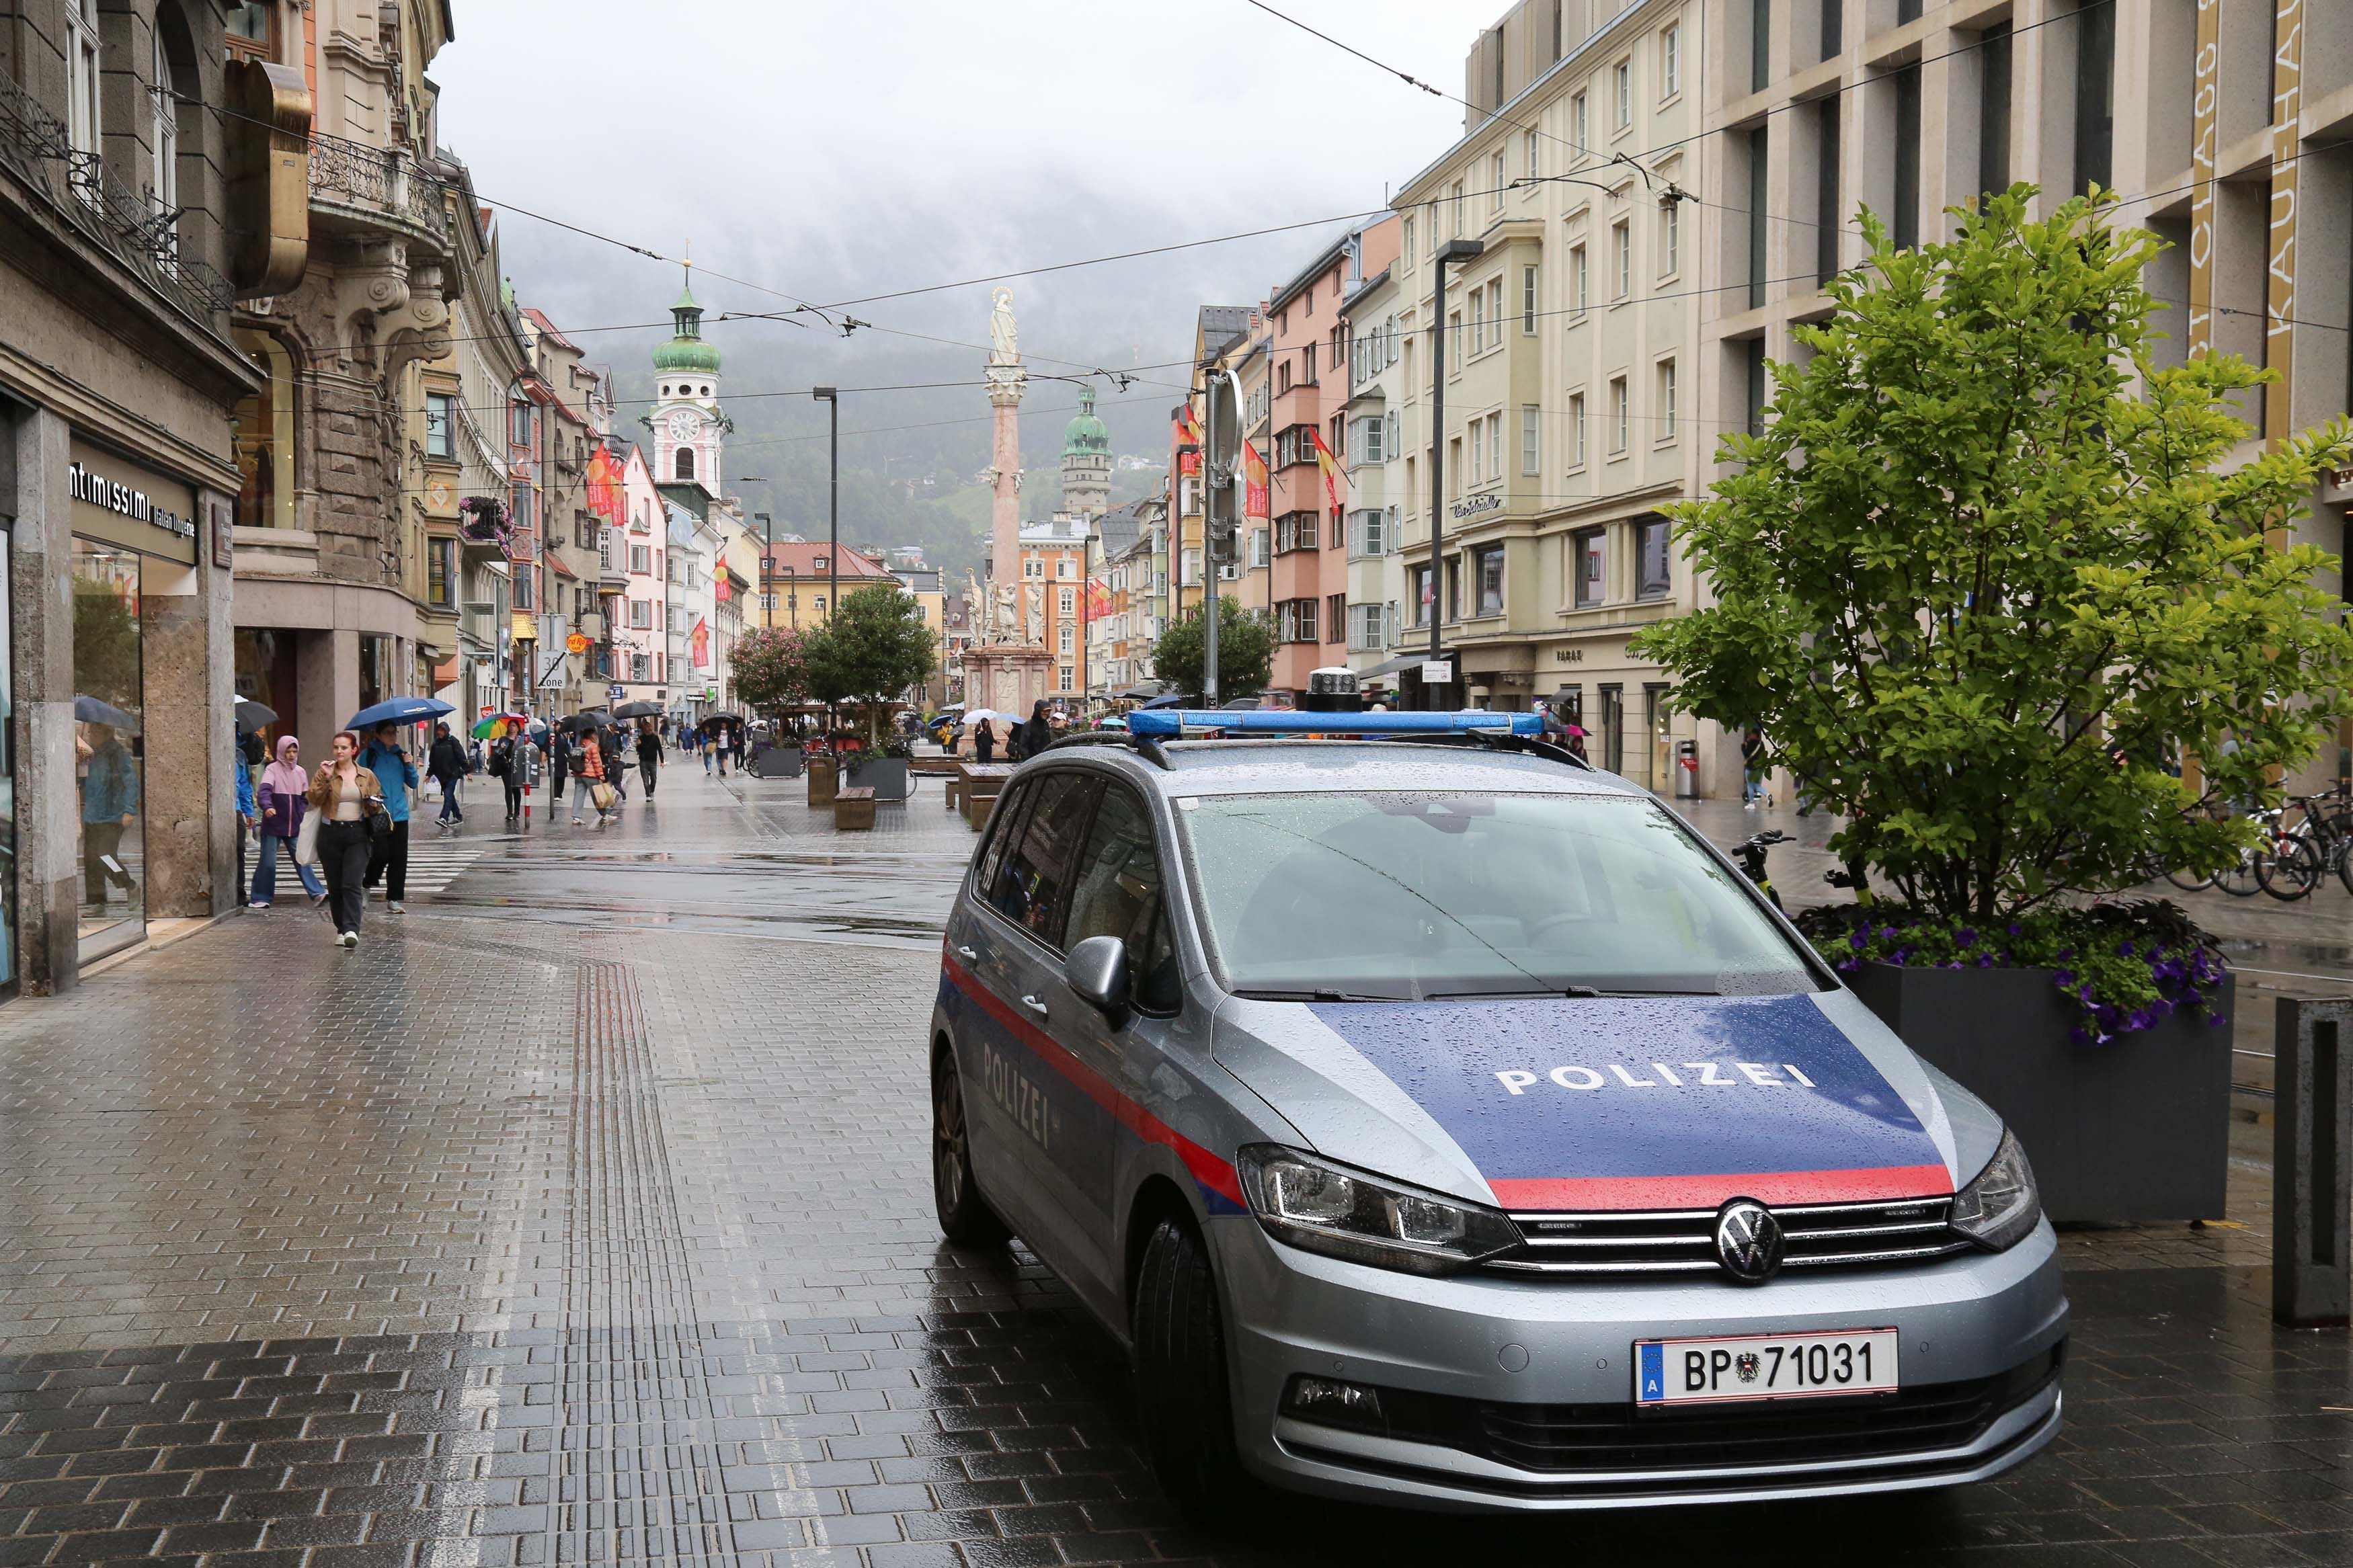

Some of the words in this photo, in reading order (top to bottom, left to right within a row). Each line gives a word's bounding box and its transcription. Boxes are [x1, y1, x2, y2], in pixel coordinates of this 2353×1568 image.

[2190, 42, 2217, 269] CLASS
[154, 505, 173, 532] Italian
[173, 513, 196, 538] lingerie
[544, 657, 559, 671] 30
[541, 677, 563, 687] Zone
[1494, 1062, 1817, 1096] POLIZEI
[984, 1042, 1048, 1151] POLIZEI
[1646, 1379, 1659, 1393] A
[1685, 1350, 1732, 1391] BP
[1764, 1341, 1872, 1388] 71031
